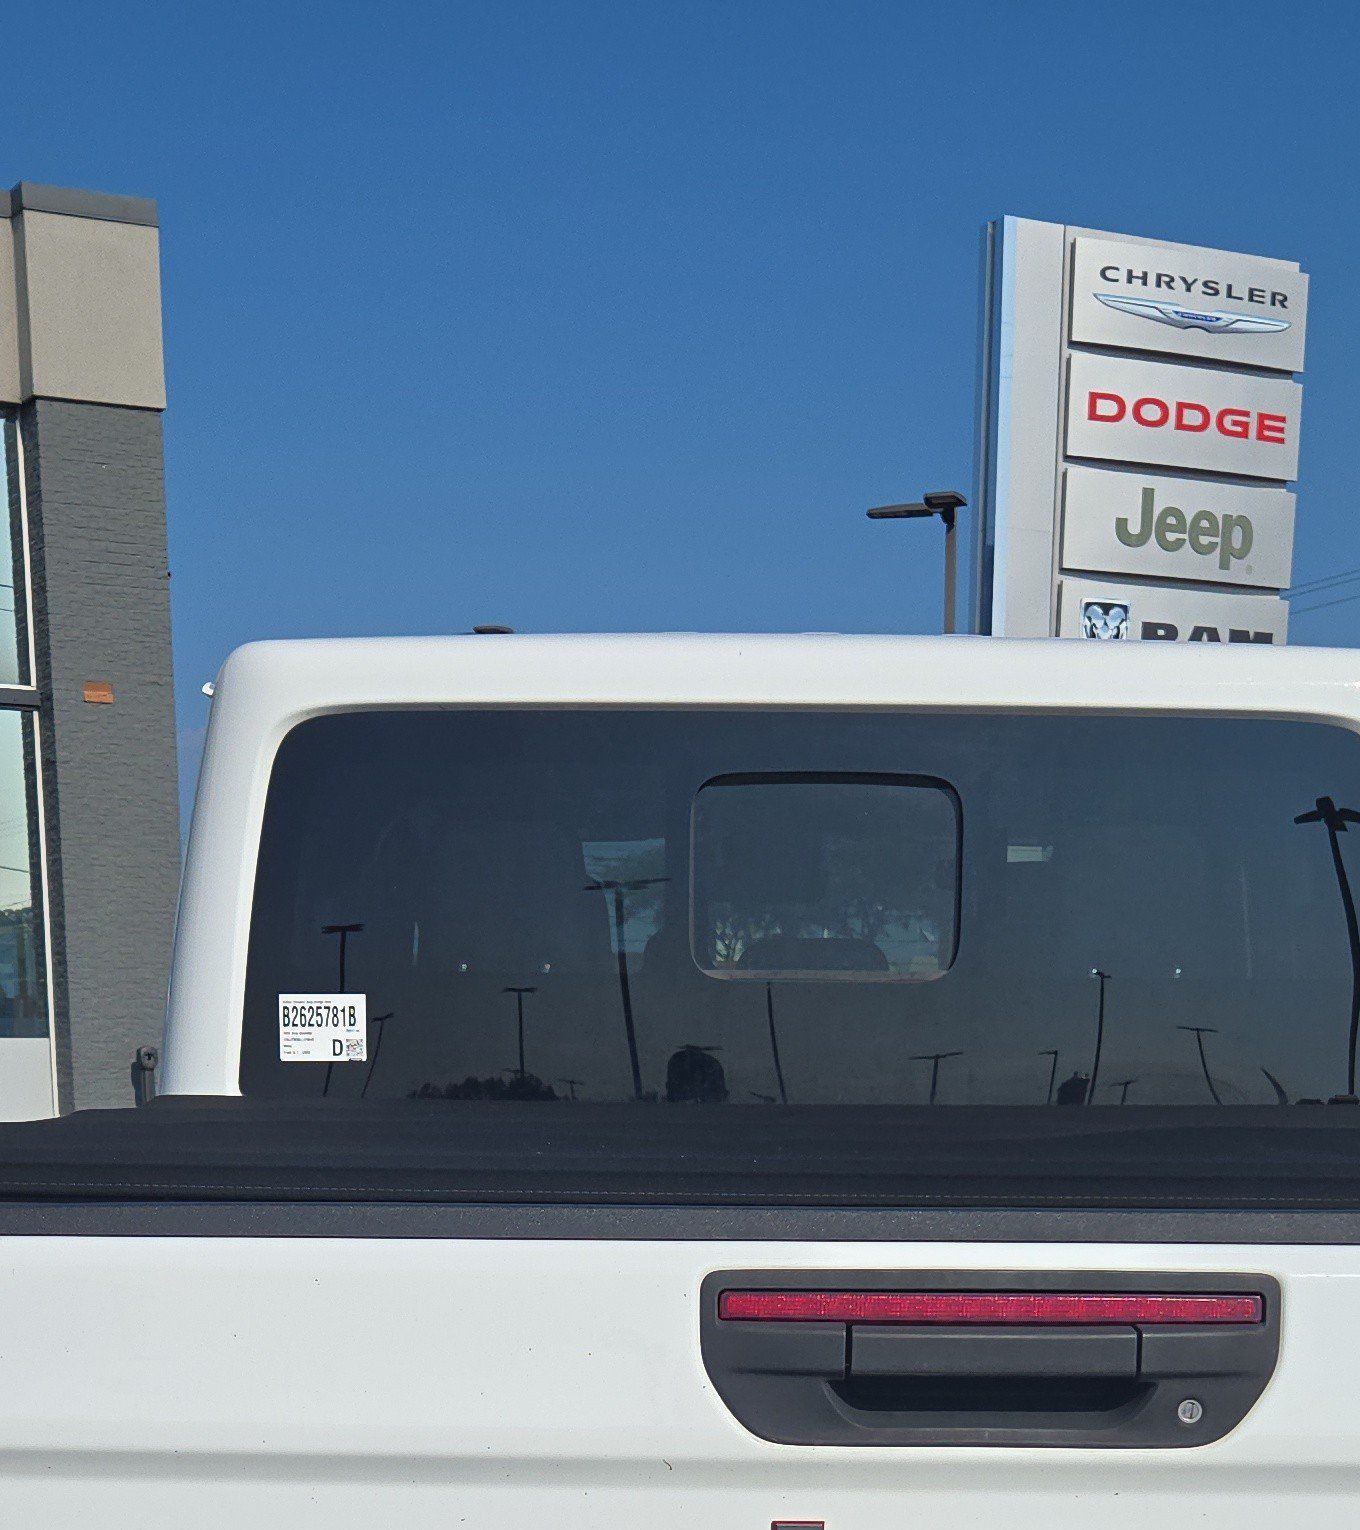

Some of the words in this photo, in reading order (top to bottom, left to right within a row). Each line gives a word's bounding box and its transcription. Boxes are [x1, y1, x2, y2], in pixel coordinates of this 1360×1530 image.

[1099, 265, 1290, 310] CHRYSLER
[1086, 390, 1287, 445] DODGE
[1114, 487, 1254, 571] Jeep
[282, 1005, 357, 1028] B2625781B
[332, 1038, 344, 1057] D
